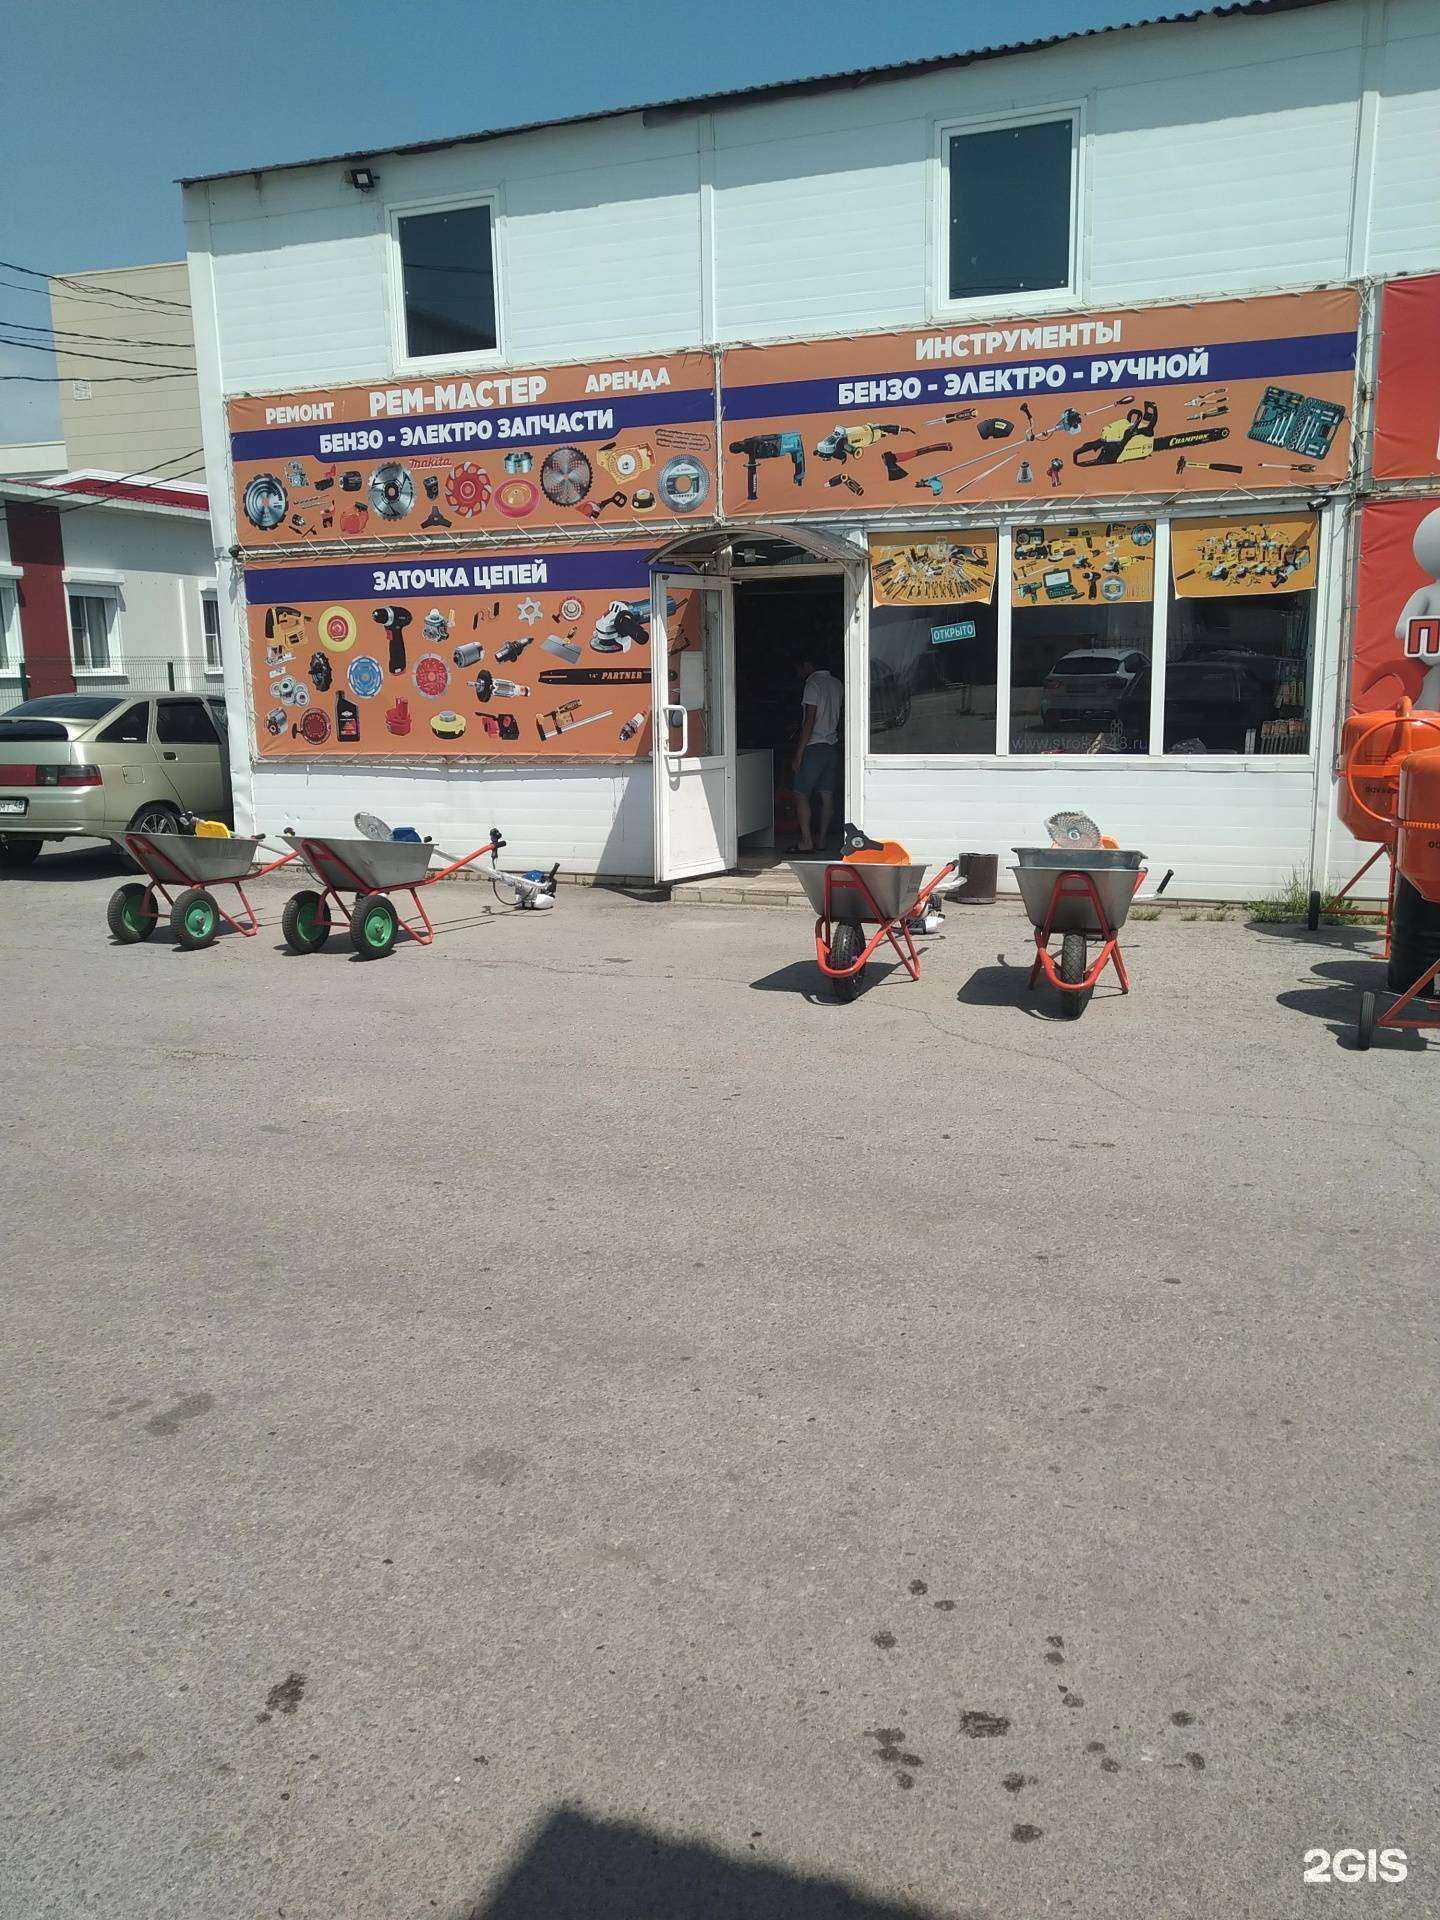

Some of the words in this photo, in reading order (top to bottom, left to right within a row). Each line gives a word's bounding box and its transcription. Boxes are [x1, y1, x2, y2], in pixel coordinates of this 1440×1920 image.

[915, 319, 1122, 361] ИНСТРУМЕНТЫ
[265, 402, 335, 425] РЕМОНТ
[369, 375, 547, 417] РЕМ-МАСТЕР
[584, 366, 671, 393] АРЕНДА
[838, 377, 922, 405] БЕНЗО
[943, 364, 1067, 396] ЭЛЕКТРО
[1090, 347, 1209, 384] РУЧНОЙ
[319, 429, 384, 454] БЕНЗО
[399, 419, 493, 447] ЭЛЕКТРО
[497, 408, 613, 438] ЗАПЧАСТИ
[372, 566, 470, 591] ЗАТОЧКА
[473, 558, 548, 589] ЦЕПЕЙ
[933, 624, 973, 641] ОТКРЫТО
[601, 671, 642, 680] PARTNER
